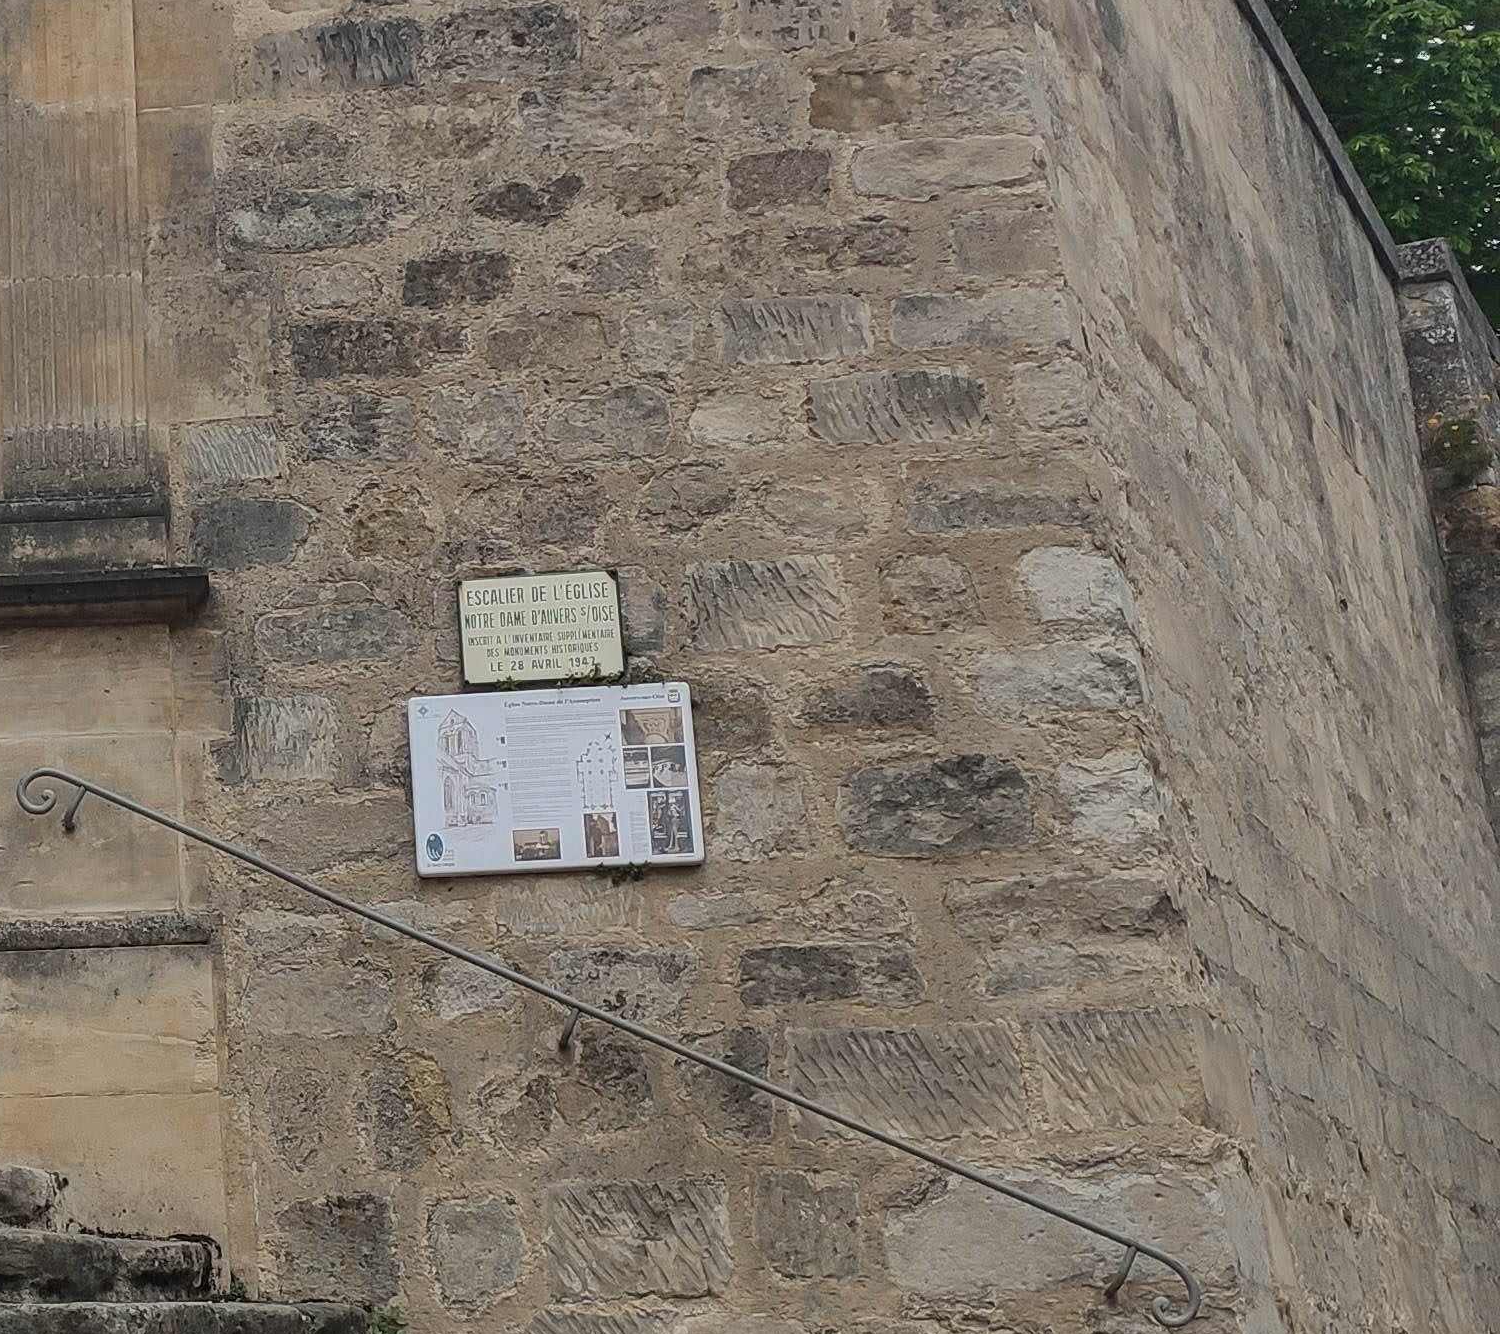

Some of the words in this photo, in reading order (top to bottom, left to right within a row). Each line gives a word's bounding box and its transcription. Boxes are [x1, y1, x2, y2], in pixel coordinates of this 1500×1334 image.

[467, 587, 525, 606] ESCALIER
[532, 585, 547, 602] DE
[553, 580, 609, 601] L'ÉGLISE
[465, 612, 495, 629] NOTRE
[500, 610, 526, 627] DAME
[532, 607, 577, 625] D'AUVERS
[504, 632, 553, 644] L'INVENTAIRE
[486, 647, 500, 657] DES
[504, 644, 548, 656] MONUMENTS
[551, 642, 599, 654] HISTORIQUES
[490, 661, 504, 672] LE
[511, 659, 524, 671] 28
[531, 657, 562, 670] AVRIL
